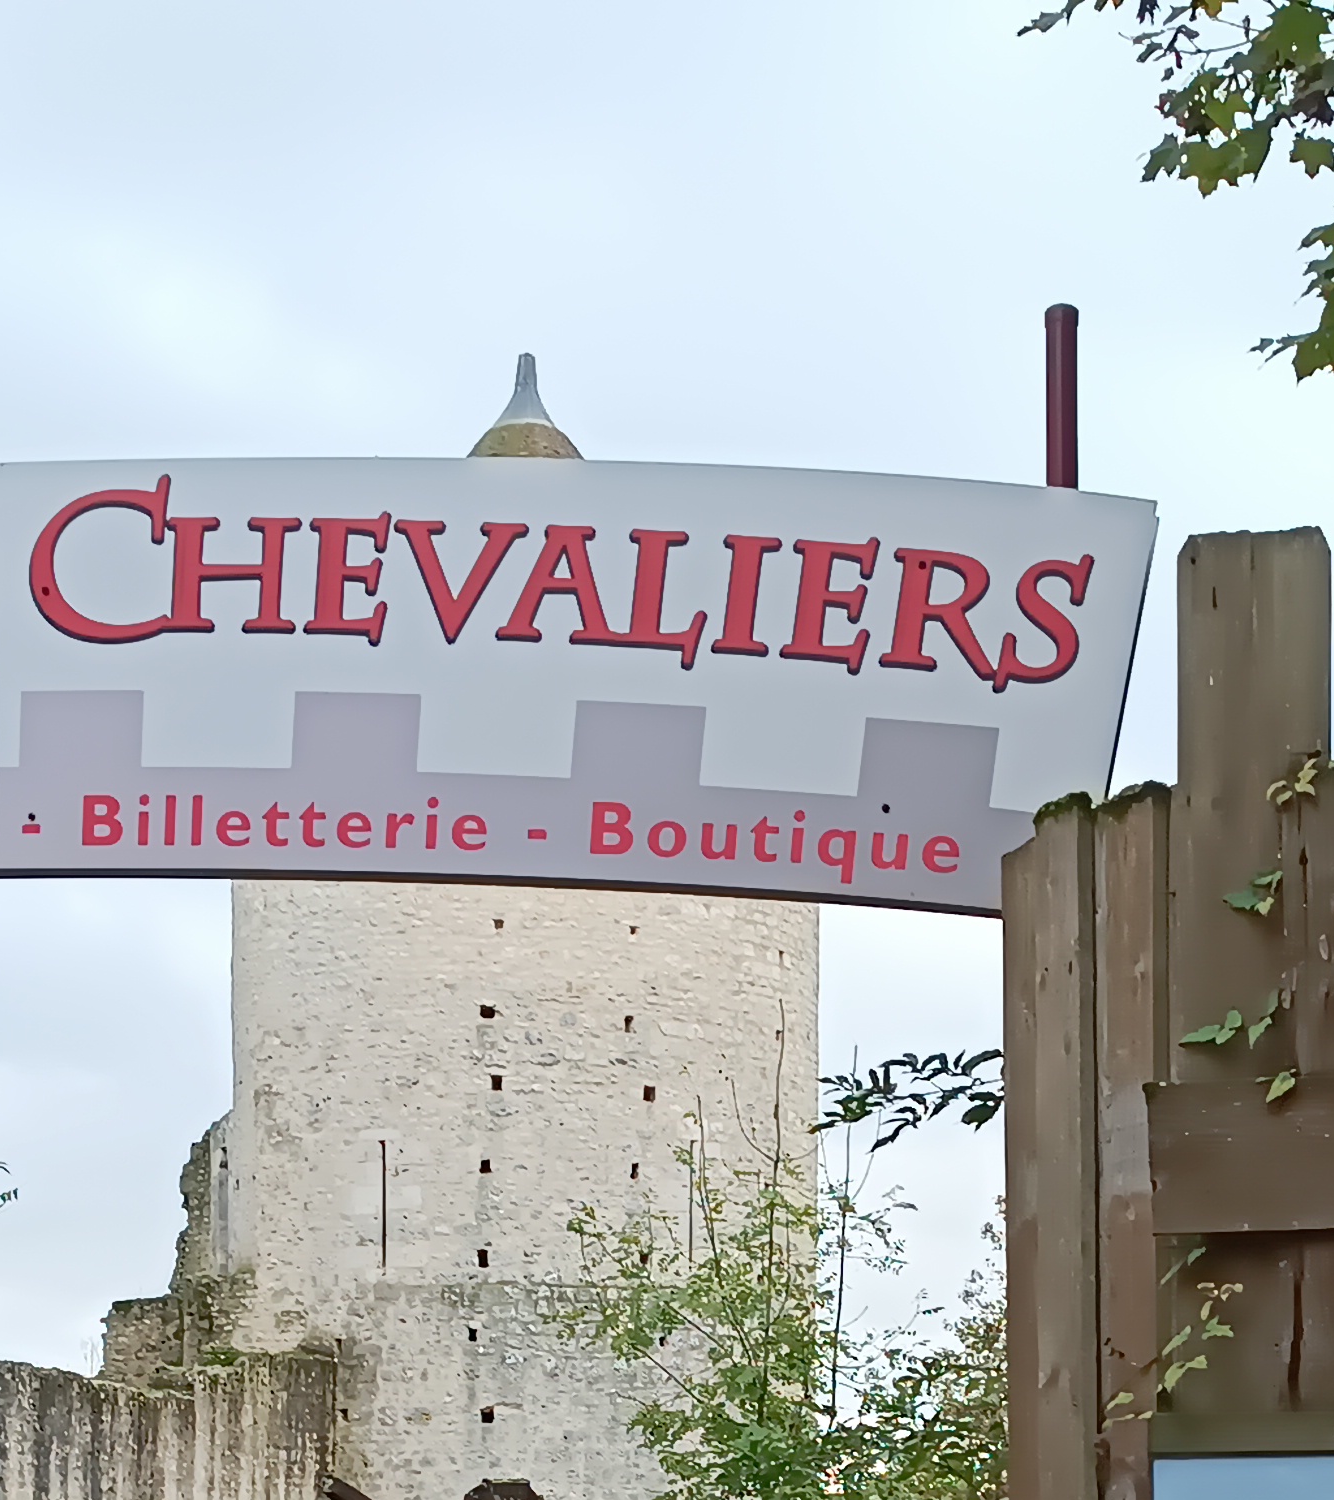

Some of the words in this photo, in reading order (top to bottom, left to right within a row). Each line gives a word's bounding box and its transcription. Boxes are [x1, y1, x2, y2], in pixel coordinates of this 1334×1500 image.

[28, 473, 1097, 694] CHEVALIERS
[82, 794, 488, 853] Billetterie
[589, 801, 961, 885] Boutique
